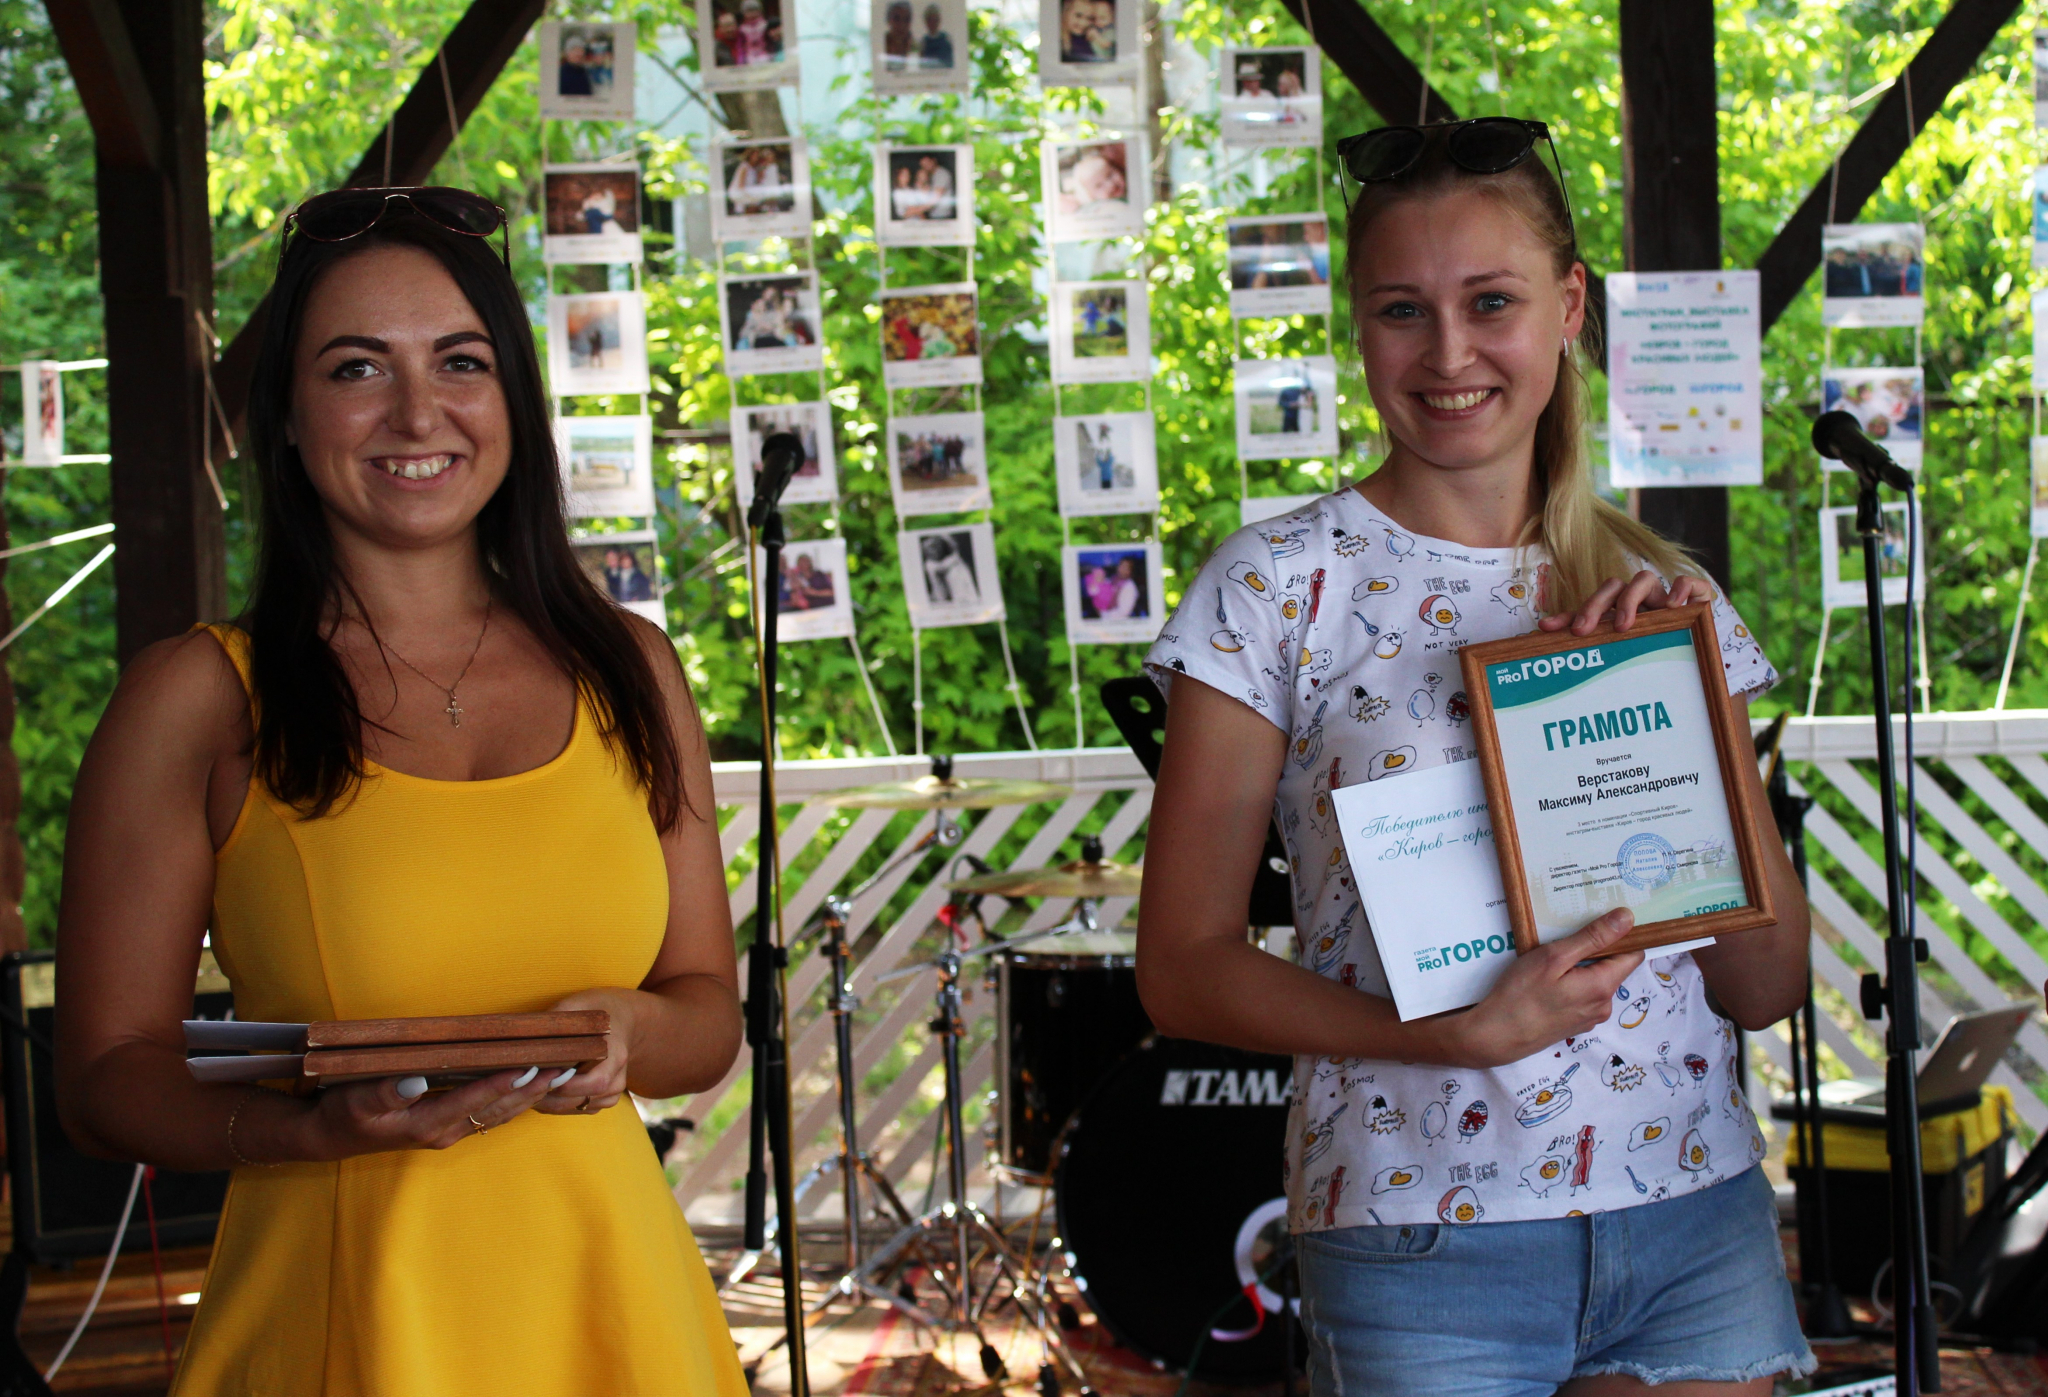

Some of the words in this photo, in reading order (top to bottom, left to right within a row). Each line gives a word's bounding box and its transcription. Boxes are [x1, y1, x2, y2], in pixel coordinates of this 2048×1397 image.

[1286, 574, 1310, 589] BRO!
[1449, 579, 1471, 595] EGG
[1424, 642, 1445, 651] NOT
[1521, 649, 1604, 681] ГОРОД
[1543, 701, 1673, 752] ГРАМОТА
[1596, 753, 1632, 766] Вручается
[1577, 765, 1651, 788] Верстакову
[1538, 792, 1593, 812] Максиму
[1597, 772, 1699, 801] Александровичу
[1361, 814, 1465, 839] Победителю
[1463, 826, 1495, 846] горо
[1413, 946, 1437, 957] газета
[1343, 1074, 1375, 1093] COSMOS
[1546, 1134, 1576, 1152] BRO!
[1448, 1162, 1473, 1183] THE
[1474, 1161, 1499, 1184] EGG
